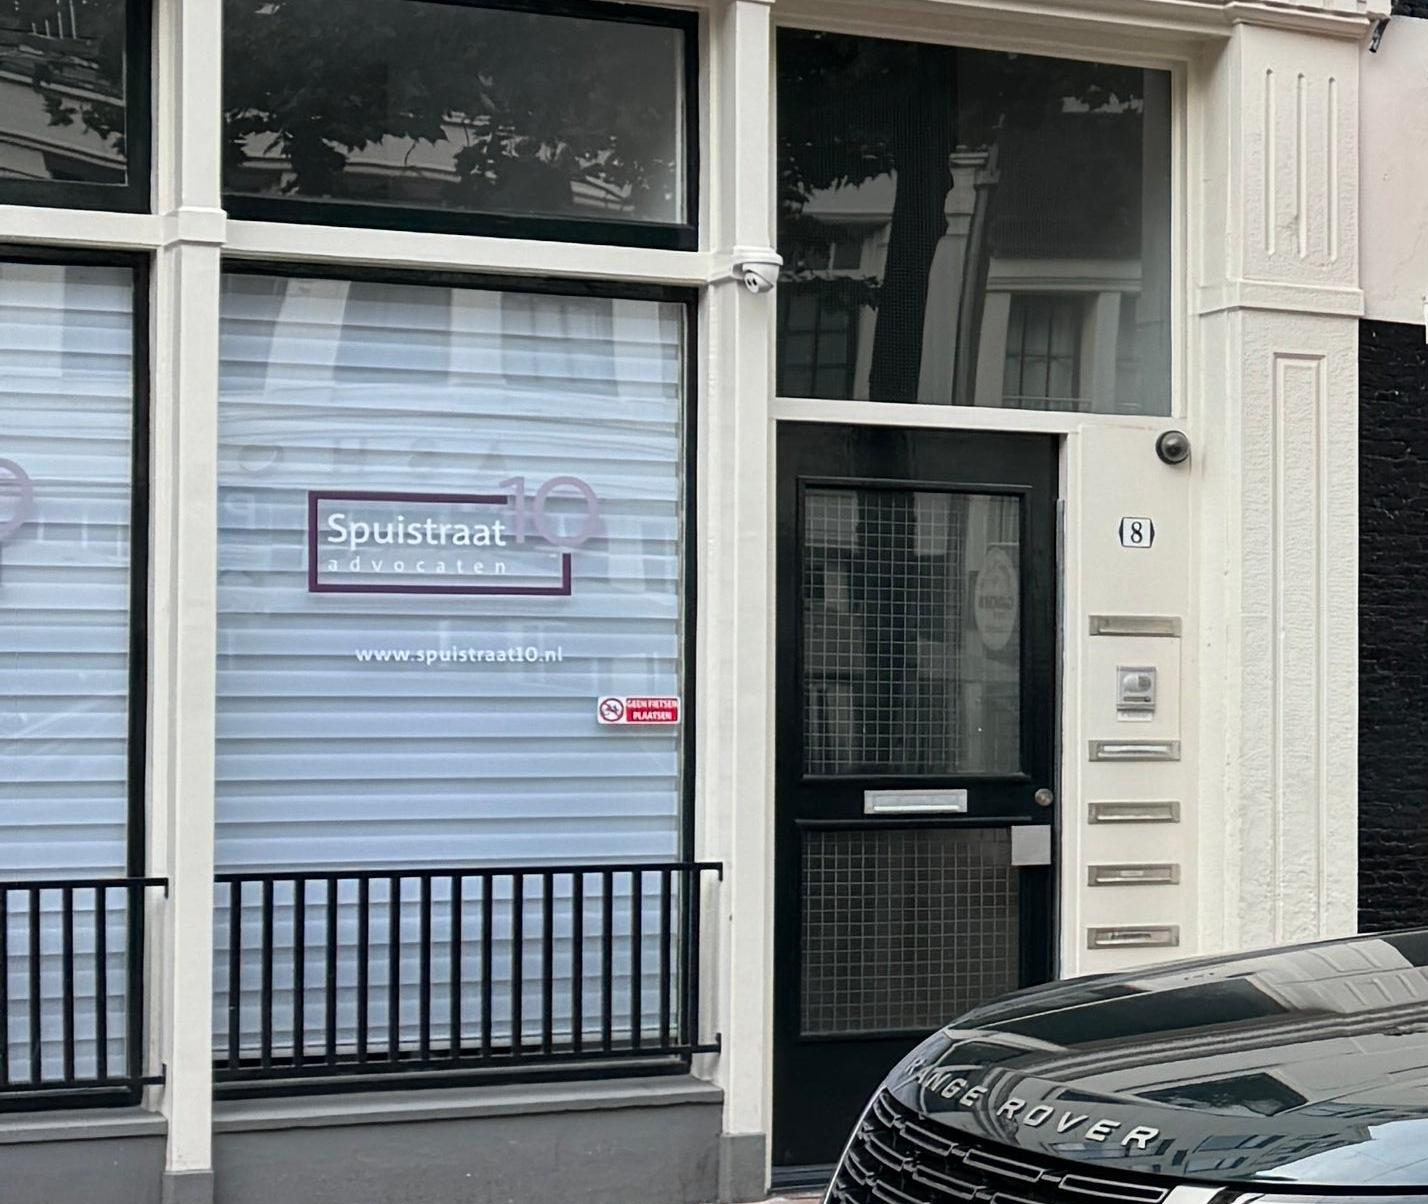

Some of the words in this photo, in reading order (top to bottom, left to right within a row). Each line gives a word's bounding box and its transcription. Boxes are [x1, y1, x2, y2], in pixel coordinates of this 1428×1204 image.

[327, 512, 507, 551] Spuistraat
[498, 475, 599, 546] 10
[1129, 520, 1144, 544] 8
[327, 555, 506, 574] advocaten
[355, 645, 564, 666] www.spuistraat10.nl
[632, 711, 672, 720] PLAATSEN
[905, 1057, 989, 1107] RANGE
[996, 1096, 1161, 1150] ROVER
